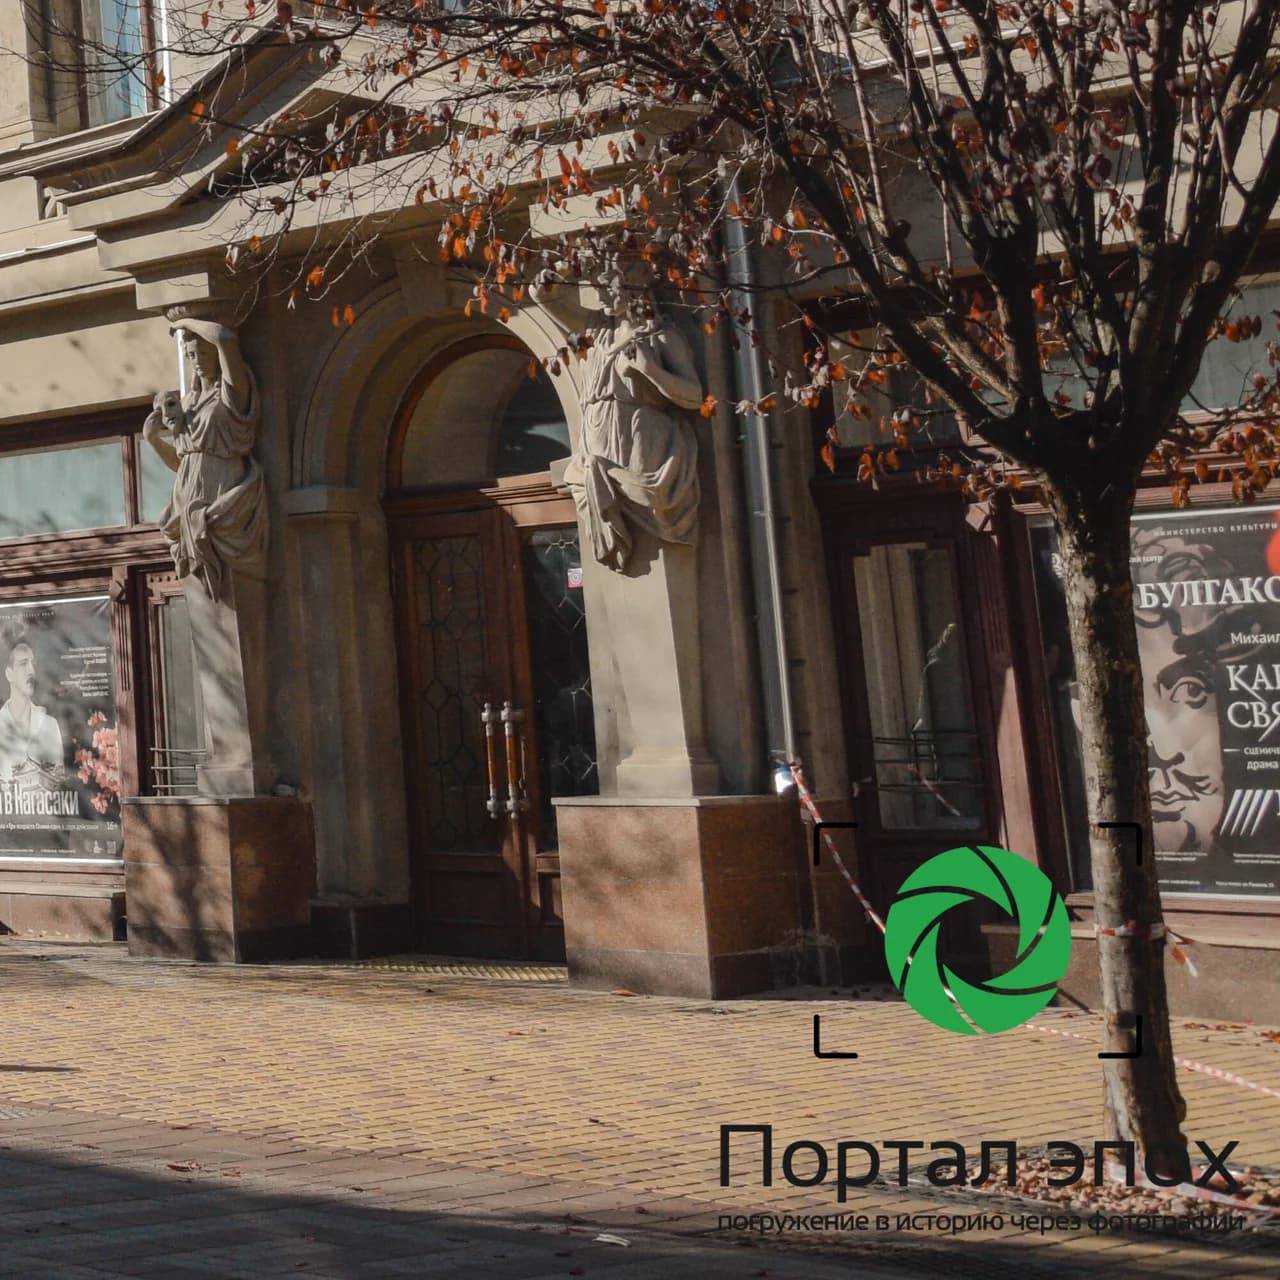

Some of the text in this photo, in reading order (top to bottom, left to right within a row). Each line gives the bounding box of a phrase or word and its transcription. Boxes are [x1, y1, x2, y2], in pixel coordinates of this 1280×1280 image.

[1246, 760, 1279, 771] драма
[4, 790, 14, 816] в
[14, 783, 80, 816] Нагасаки
